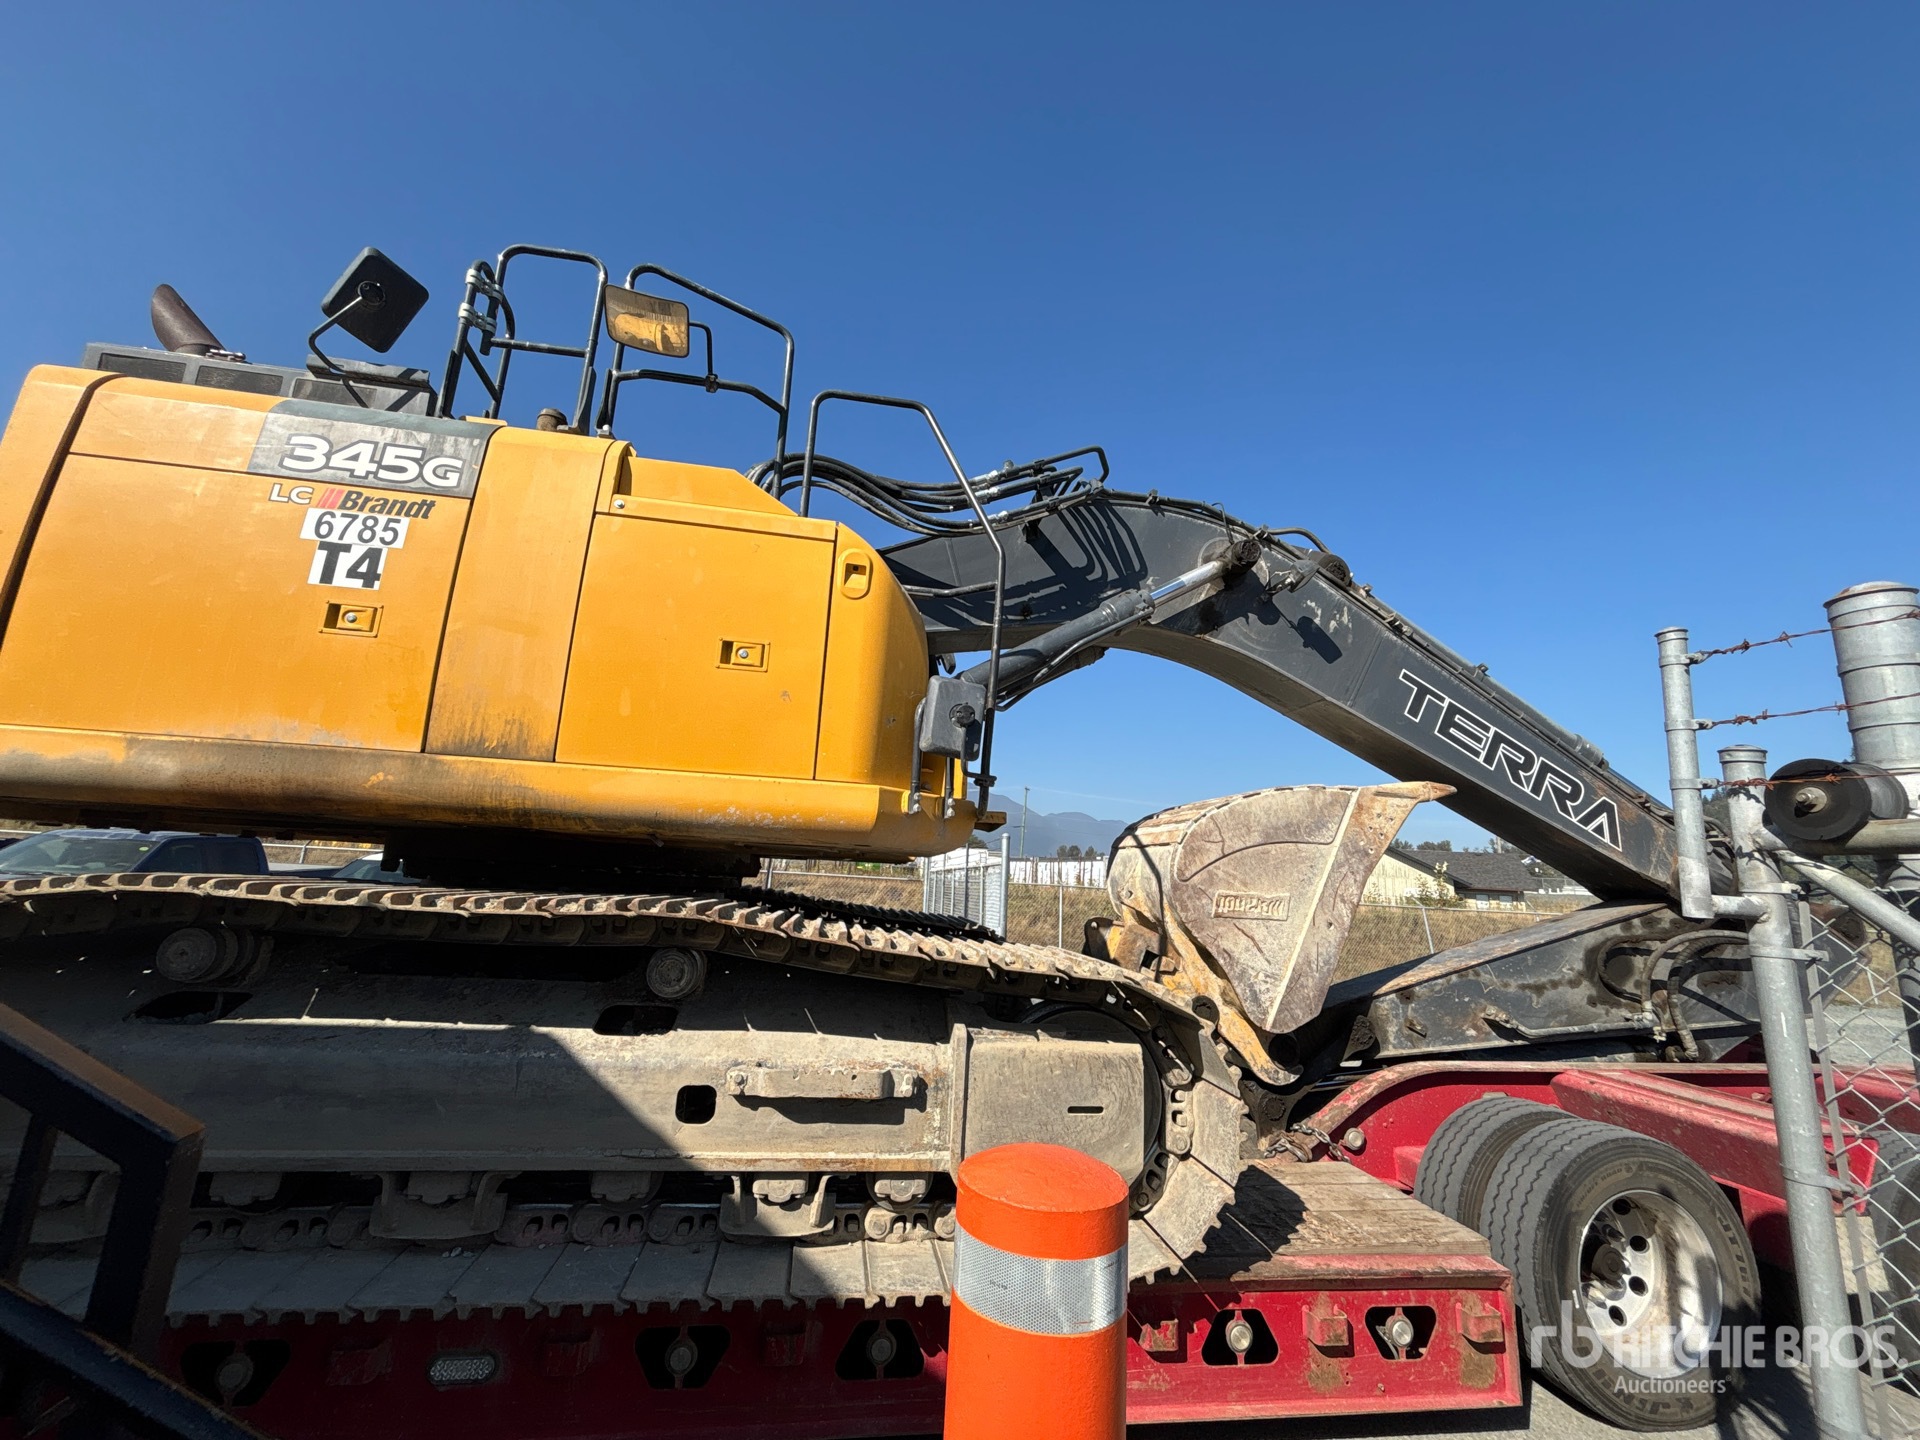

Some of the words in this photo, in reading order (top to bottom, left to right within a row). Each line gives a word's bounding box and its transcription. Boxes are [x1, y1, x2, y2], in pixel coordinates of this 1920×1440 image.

[280, 434, 465, 488] 345G
[268, 483, 314, 504] LC
[338, 490, 436, 519] Brandt
[313, 511, 401, 546] 6785
[318, 541, 381, 589] T4
[1399, 668, 1622, 852] TERRA
